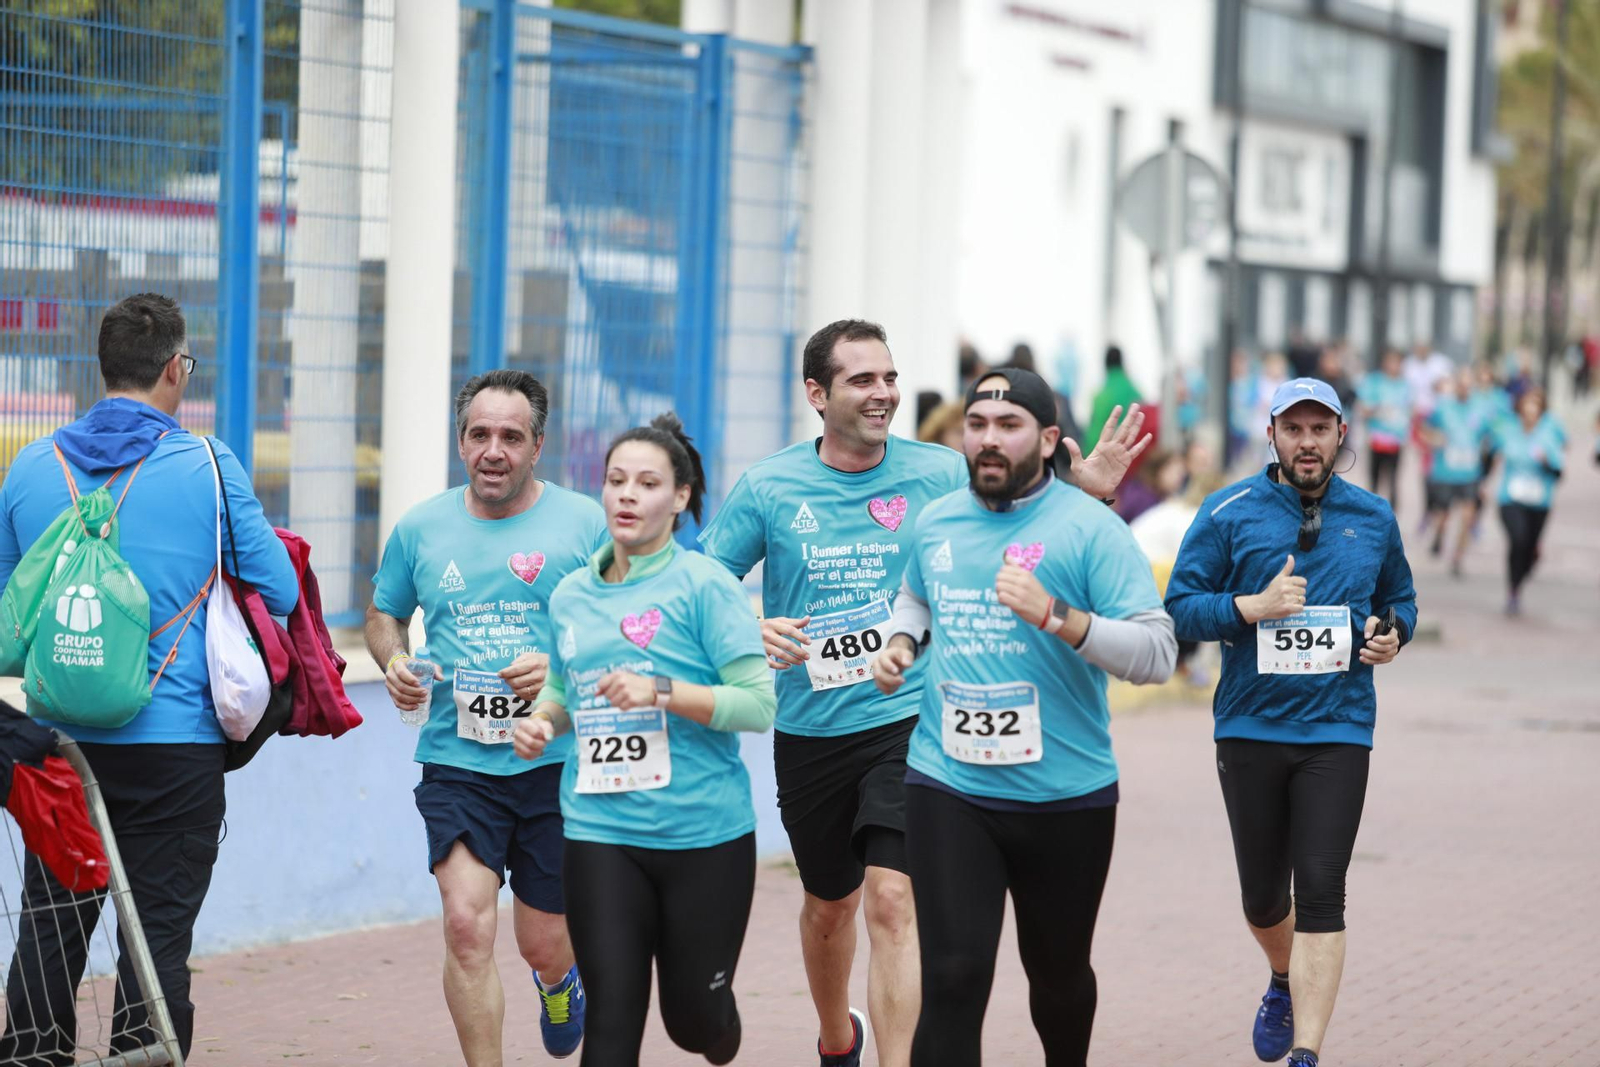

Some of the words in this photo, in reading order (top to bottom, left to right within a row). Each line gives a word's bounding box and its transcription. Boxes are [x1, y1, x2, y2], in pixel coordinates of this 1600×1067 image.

[791, 520, 819, 529] ALTEA
[802, 543, 808, 561] I
[811, 545, 853, 559] Runner
[857, 543, 900, 555] Fashion
[808, 558, 858, 571] Carrera
[861, 556, 883, 568] azul
[809, 572, 825, 583] por
[829, 570, 841, 581] el
[845, 568, 887, 582] autismo
[439, 578, 466, 589] ALTEA
[828, 591, 855, 608] nada
[854, 588, 868, 600] te
[457, 602, 496, 615] Runner
[500, 601, 540, 612] Fashion
[939, 601, 986, 615] Carrera
[457, 613, 501, 627] Carrera
[504, 614, 526, 625] azul
[476, 626, 486, 638] el
[489, 624, 530, 638] autismo
[54, 633, 104, 649] GRUPO
[821, 629, 883, 662] 480
[1275, 629, 1336, 651] 594
[54, 647, 104, 656] COOPERATIVO
[473, 647, 499, 664] nada
[501, 645, 512, 658] te
[1297, 652, 1312, 660] PEPE
[53, 654, 105, 667] CAJAMAR
[844, 657, 867, 669] RAMON
[469, 695, 532, 719] 482
[489, 720, 512, 729] JUANJO
[956, 709, 1021, 737] 232
[590, 736, 648, 764] 229
